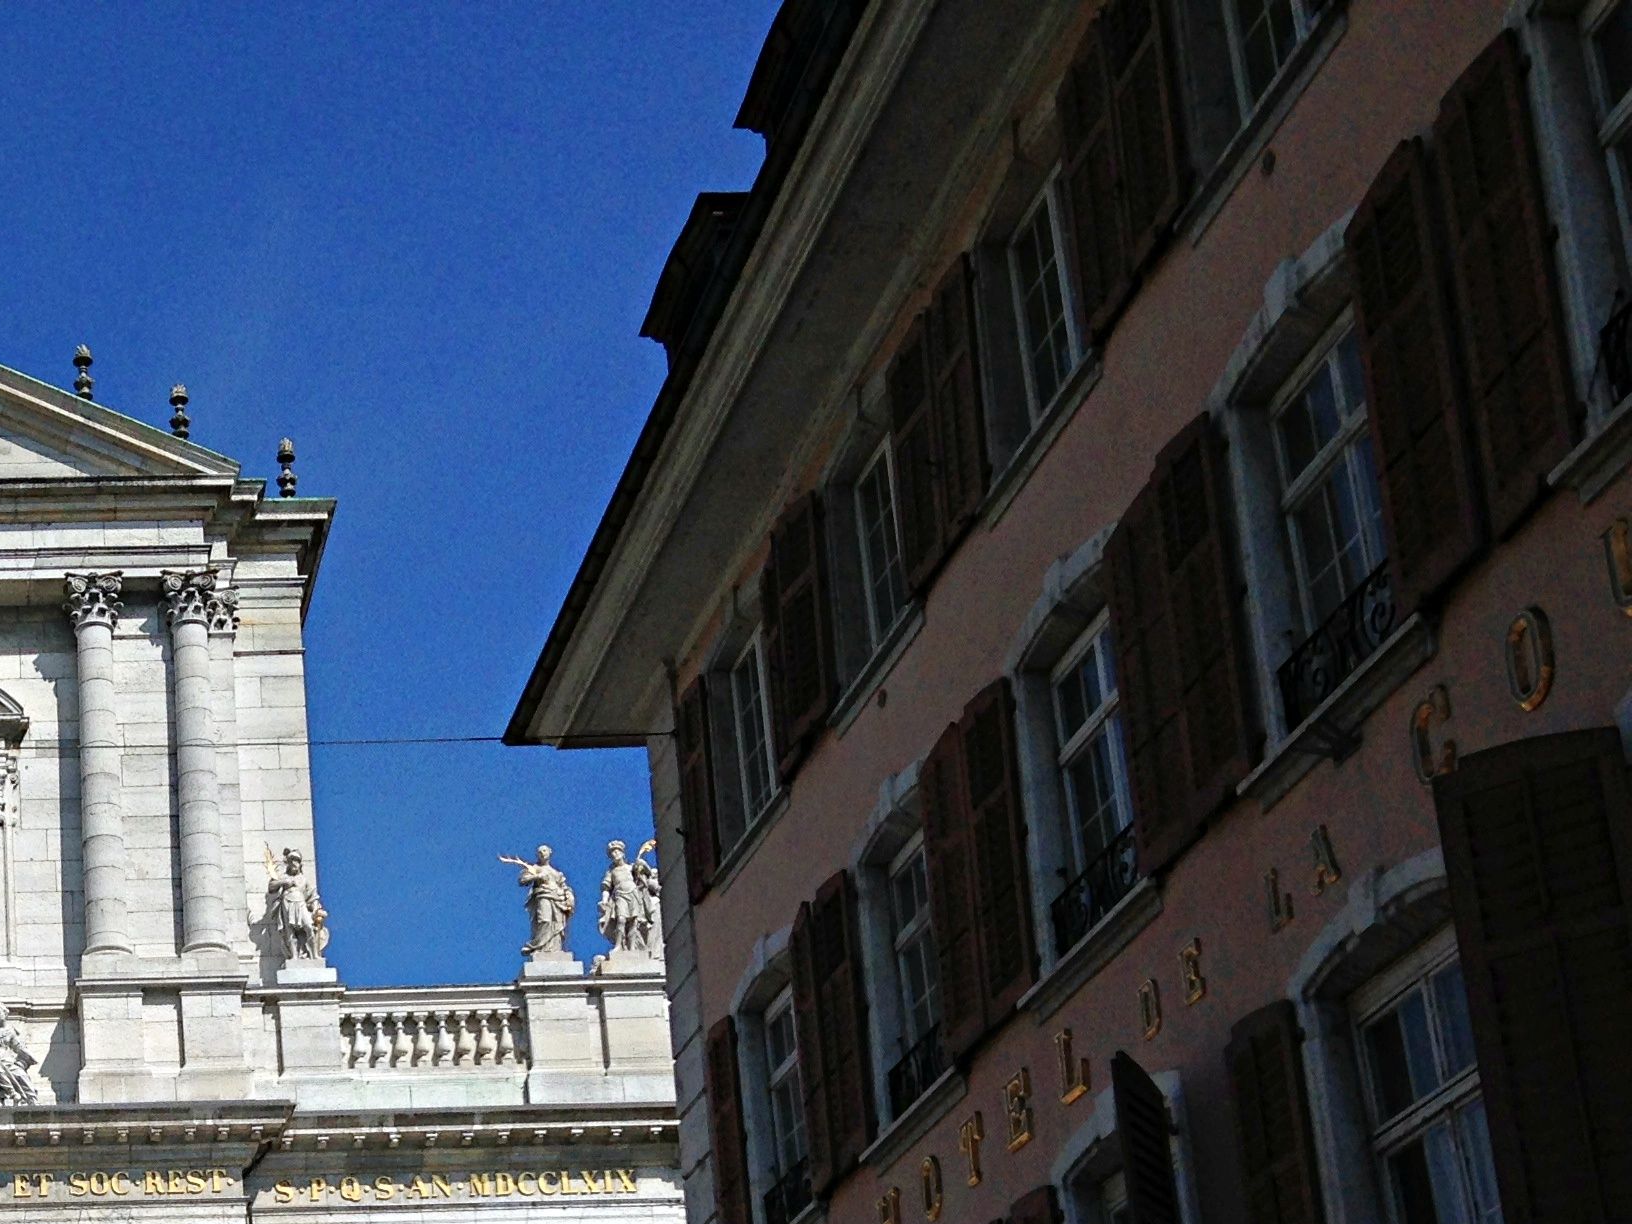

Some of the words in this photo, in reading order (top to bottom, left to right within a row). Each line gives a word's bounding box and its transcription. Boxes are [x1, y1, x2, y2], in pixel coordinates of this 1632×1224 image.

[1136, 936, 1207, 1041] DE
[1264, 823, 1342, 934] LA
[13, 1172, 54, 1198] ET
